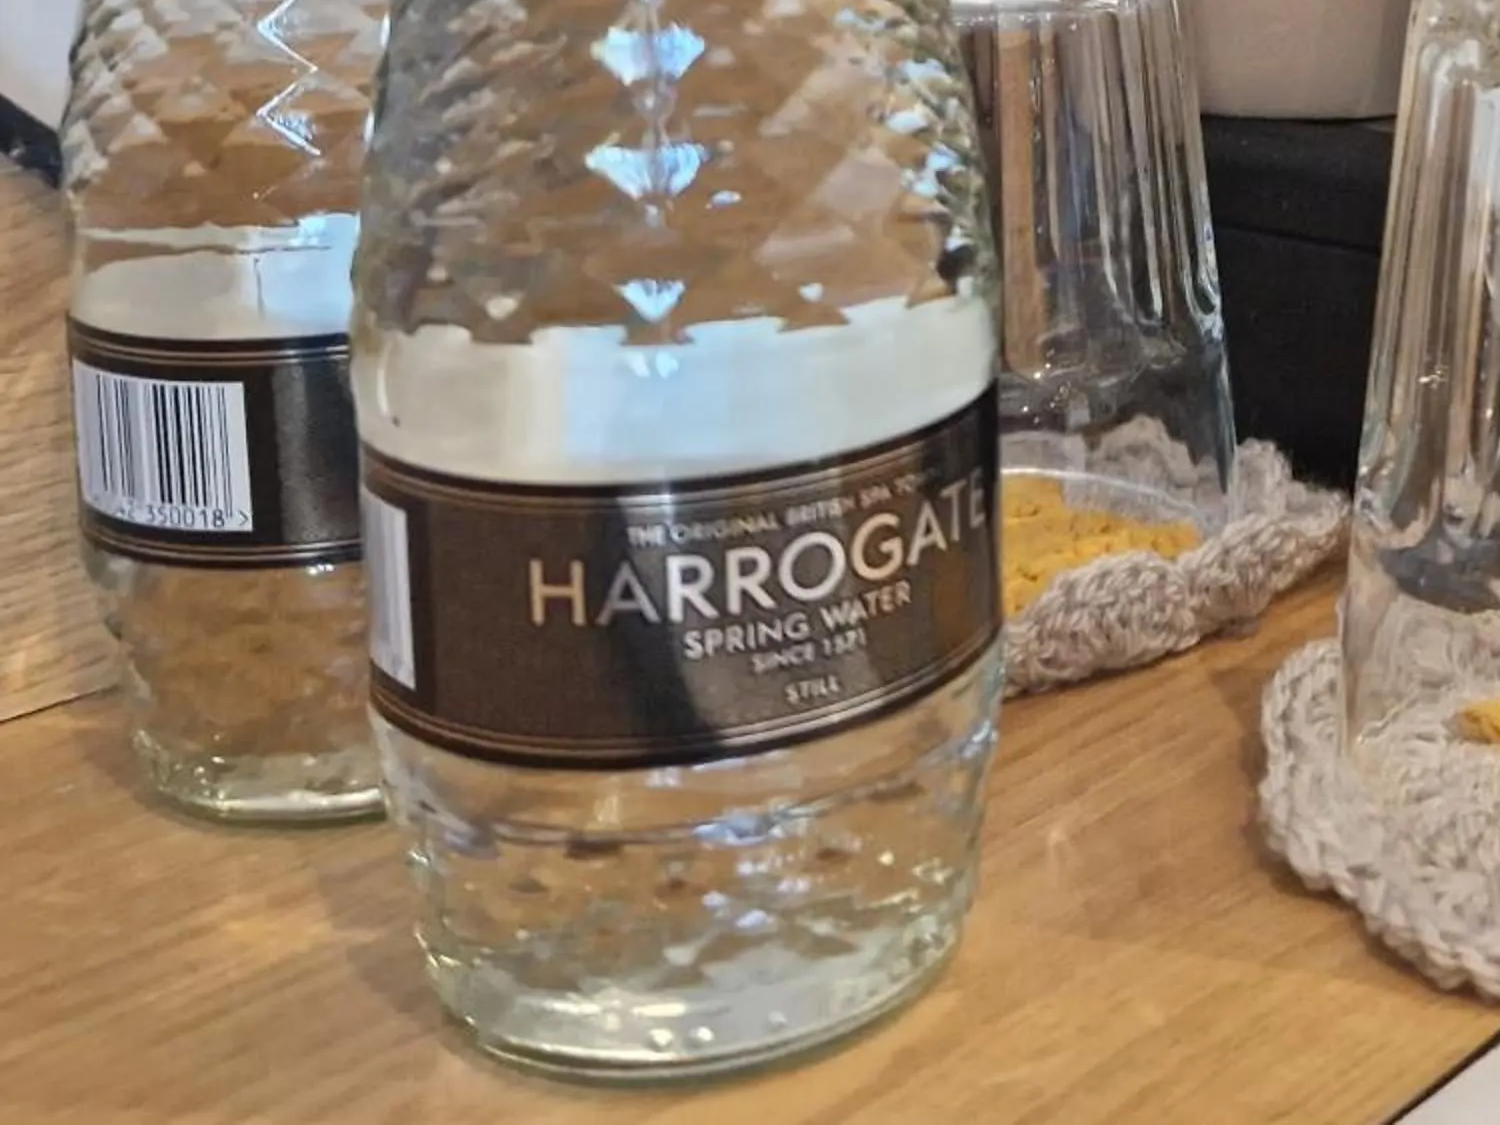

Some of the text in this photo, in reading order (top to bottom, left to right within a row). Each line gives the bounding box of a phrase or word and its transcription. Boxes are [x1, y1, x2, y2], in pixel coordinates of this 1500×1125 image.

[145, 503, 226, 528] 350018
[528, 465, 987, 627] HARROGATE
[682, 579, 912, 660] SPRING WATER
[751, 642, 816, 674] SINCE
[783, 675, 842, 705] STILL
